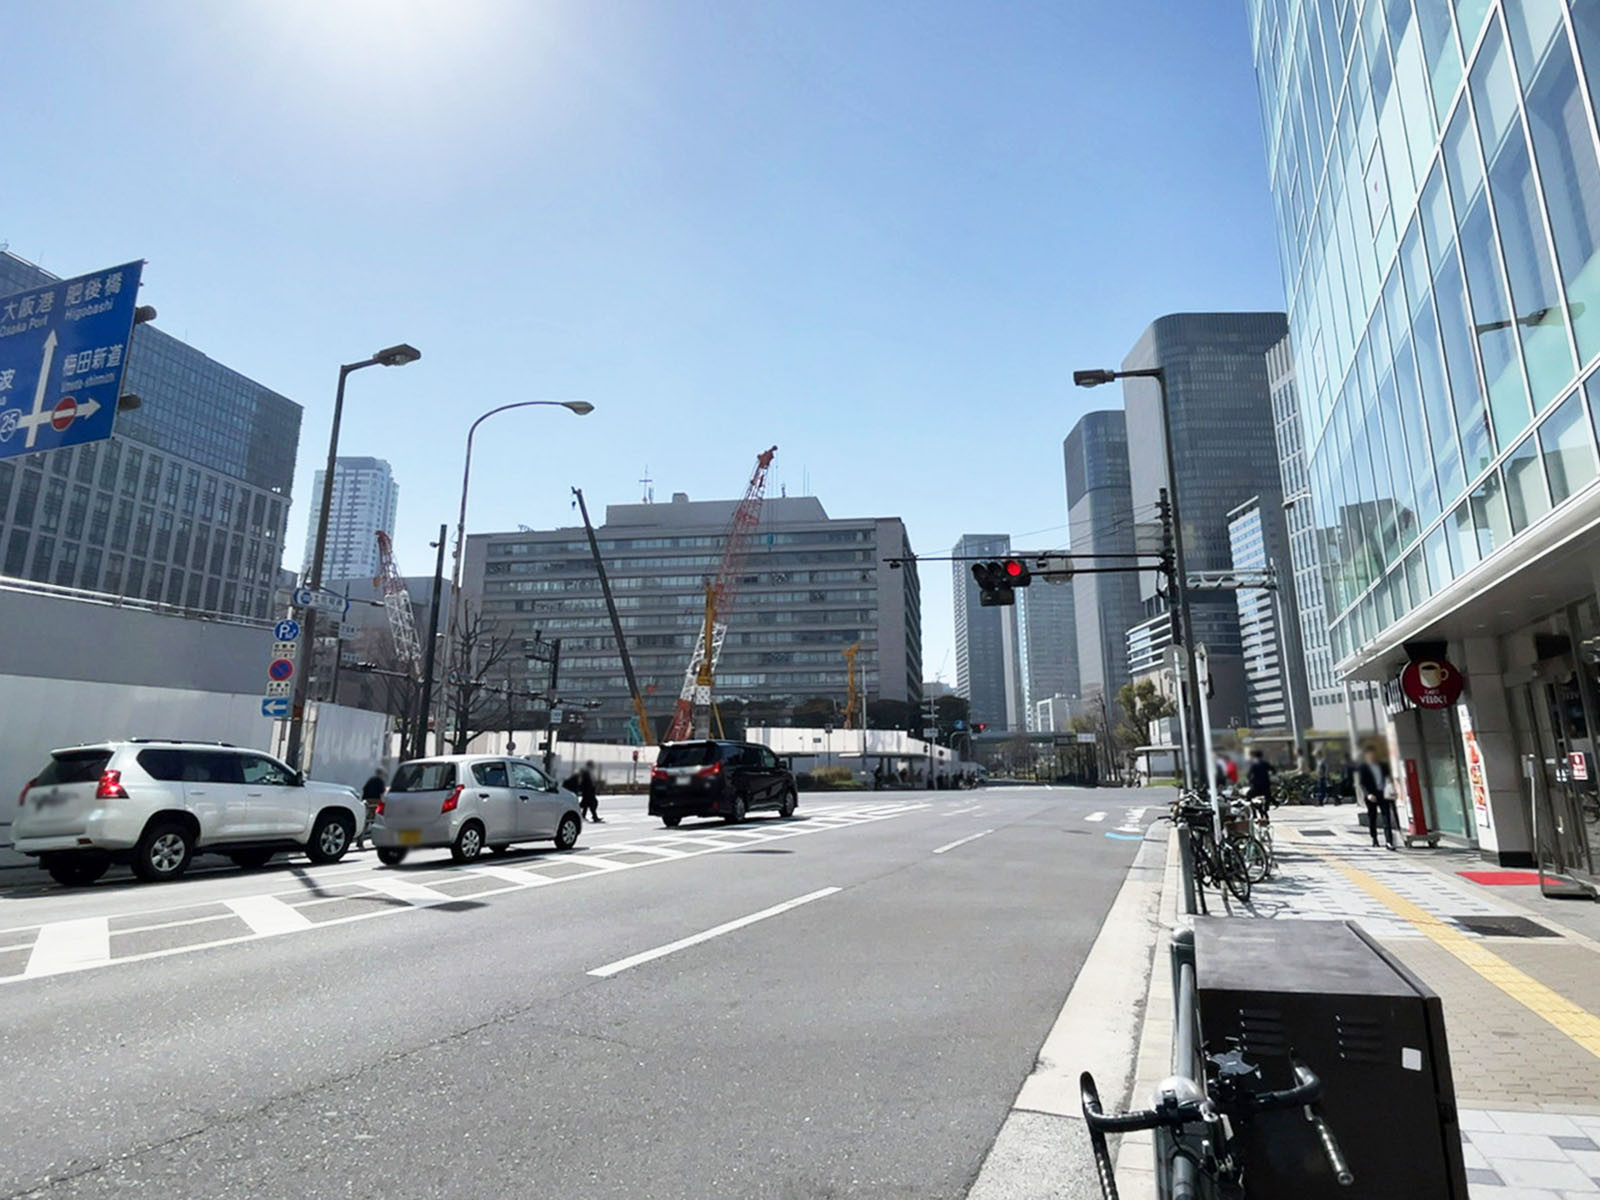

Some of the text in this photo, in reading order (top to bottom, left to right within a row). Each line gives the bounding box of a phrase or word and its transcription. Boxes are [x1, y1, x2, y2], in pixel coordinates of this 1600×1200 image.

[65, 271, 124, 307] 肥後橋
[1, 290, 56, 323] 大阪港
[1, 412, 18, 433] 25
